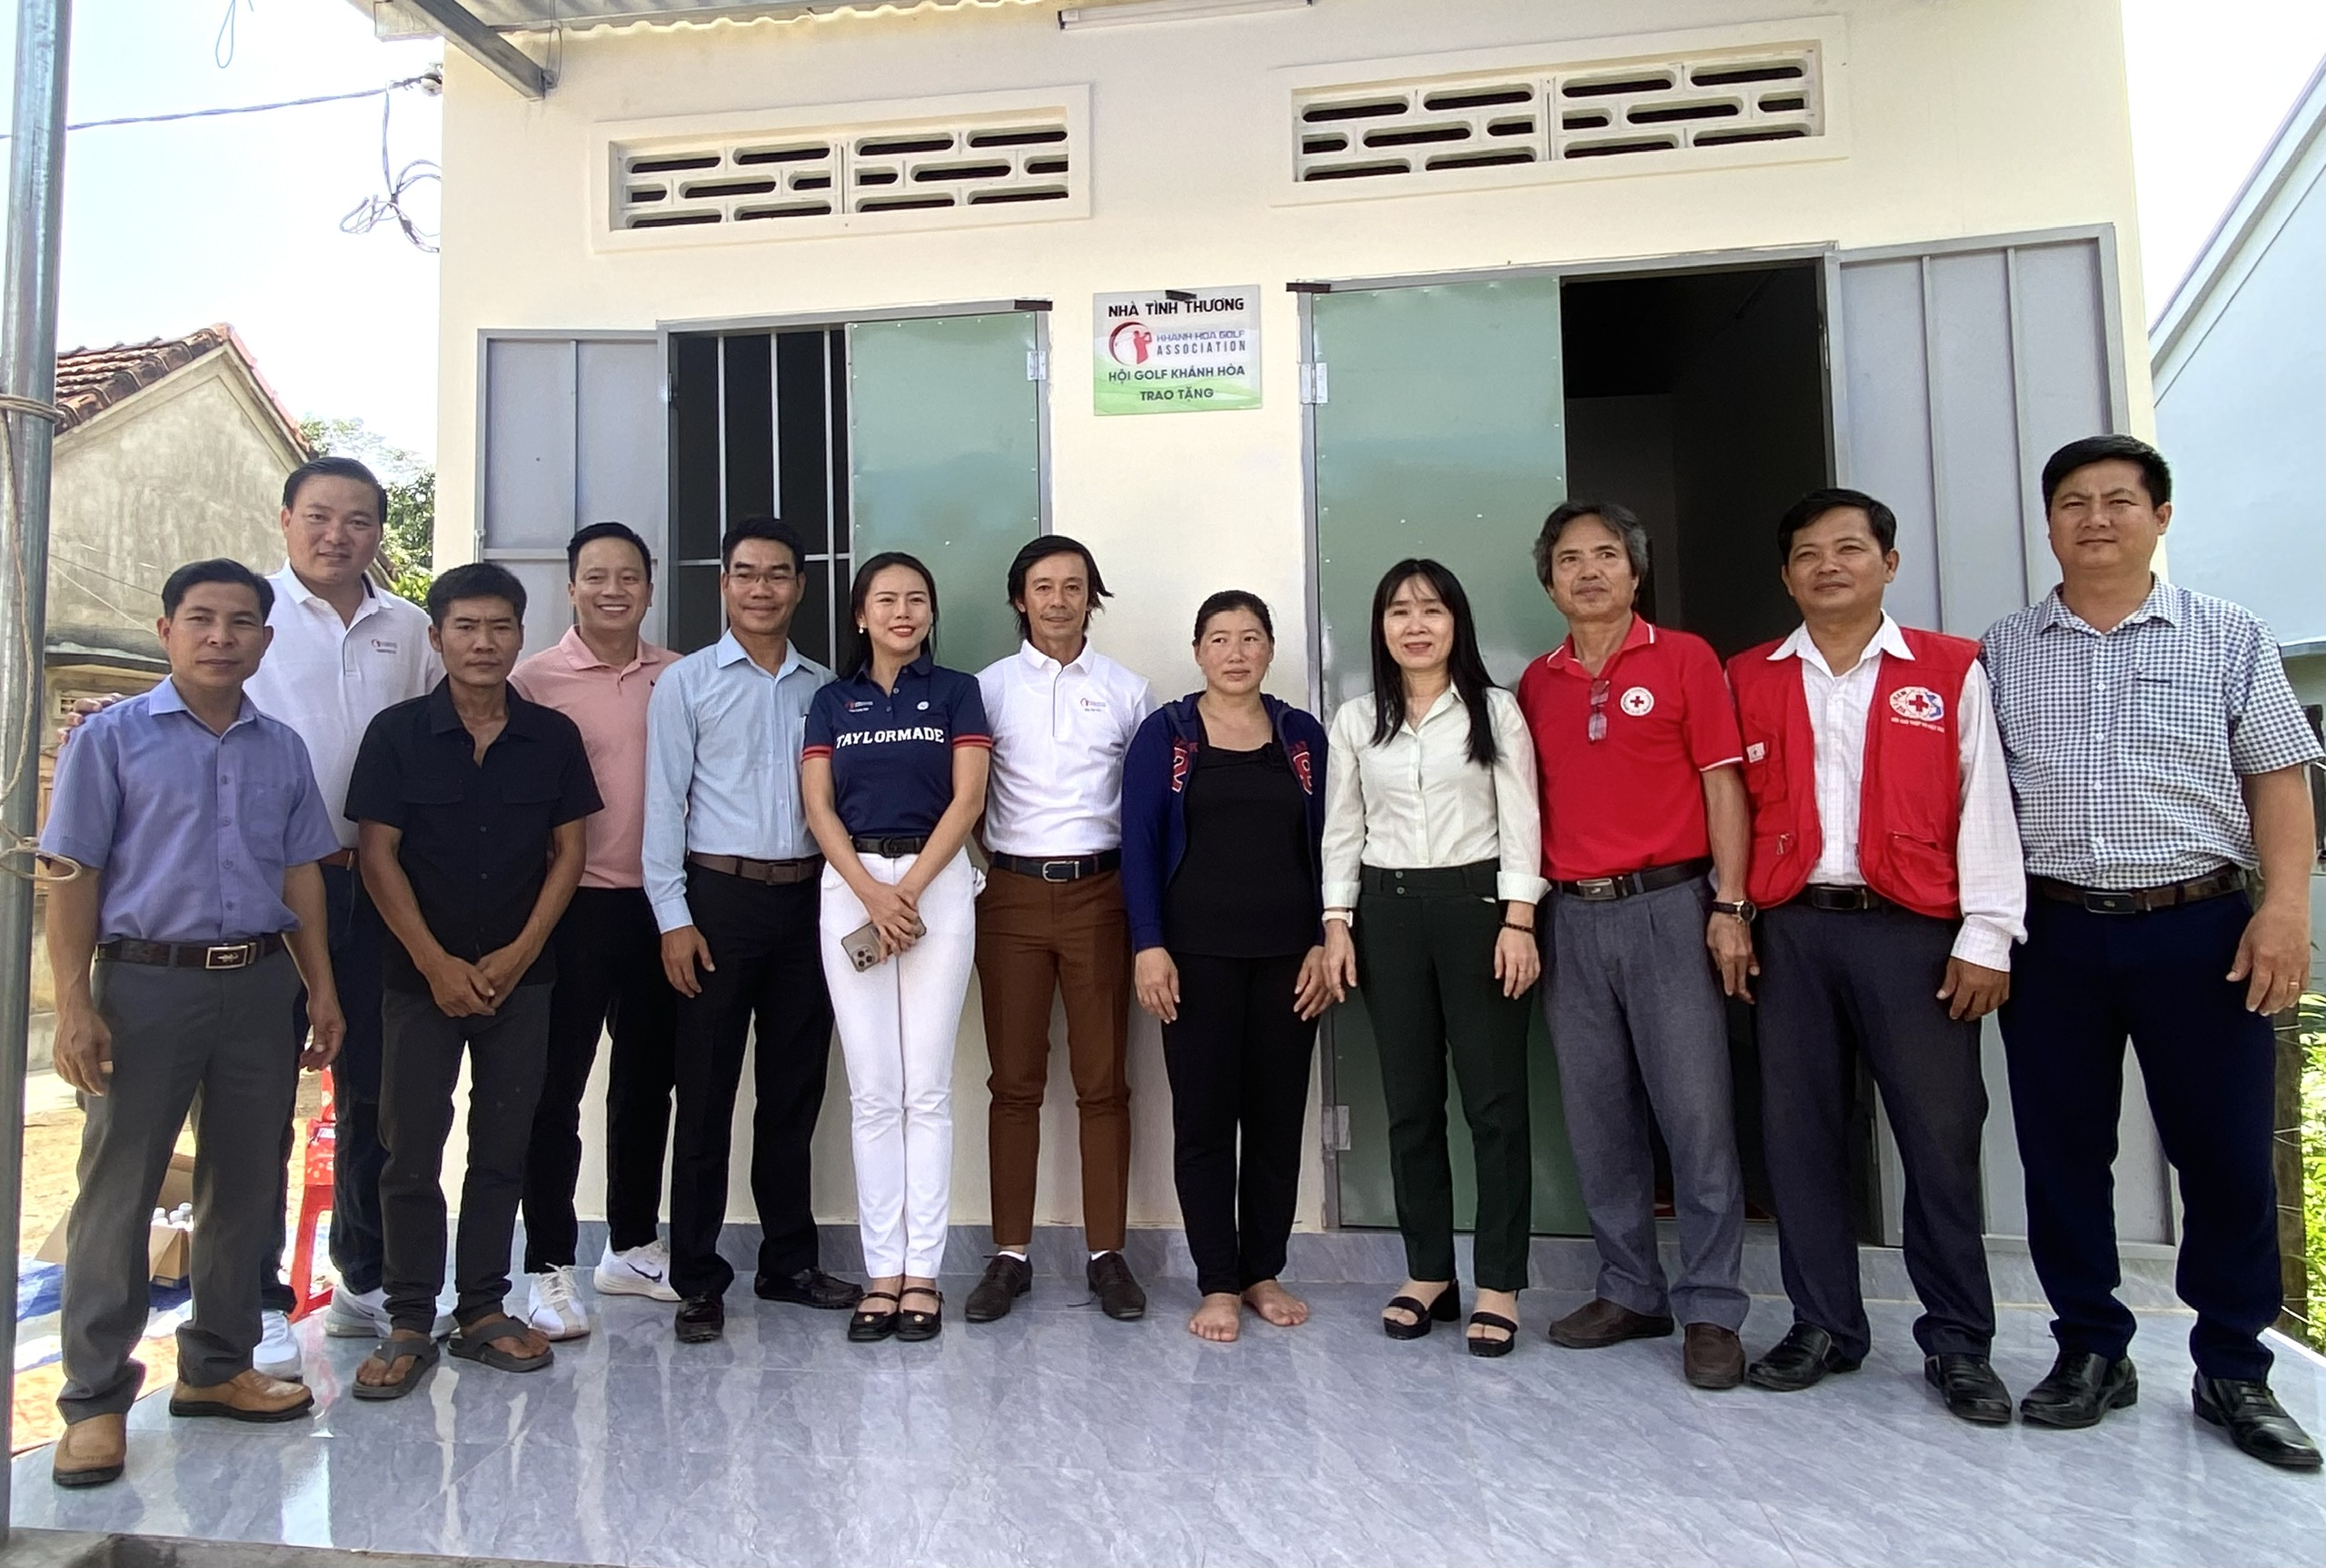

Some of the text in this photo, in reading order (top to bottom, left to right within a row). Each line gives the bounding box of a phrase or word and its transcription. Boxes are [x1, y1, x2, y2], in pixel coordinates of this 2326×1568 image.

[1108, 297, 1245, 317] NHÀ TÌNH THƯƠNG
[1157, 329, 1246, 342] KHANH HOA GOLF
[1157, 340, 1247, 355] ASSOCIATION
[1108, 363, 1246, 384] HỘI GOLF KHÁNH HÒA
[1140, 386, 1215, 402] TRAO TẶNG
[836, 727, 945, 749] TAYLORMADE
